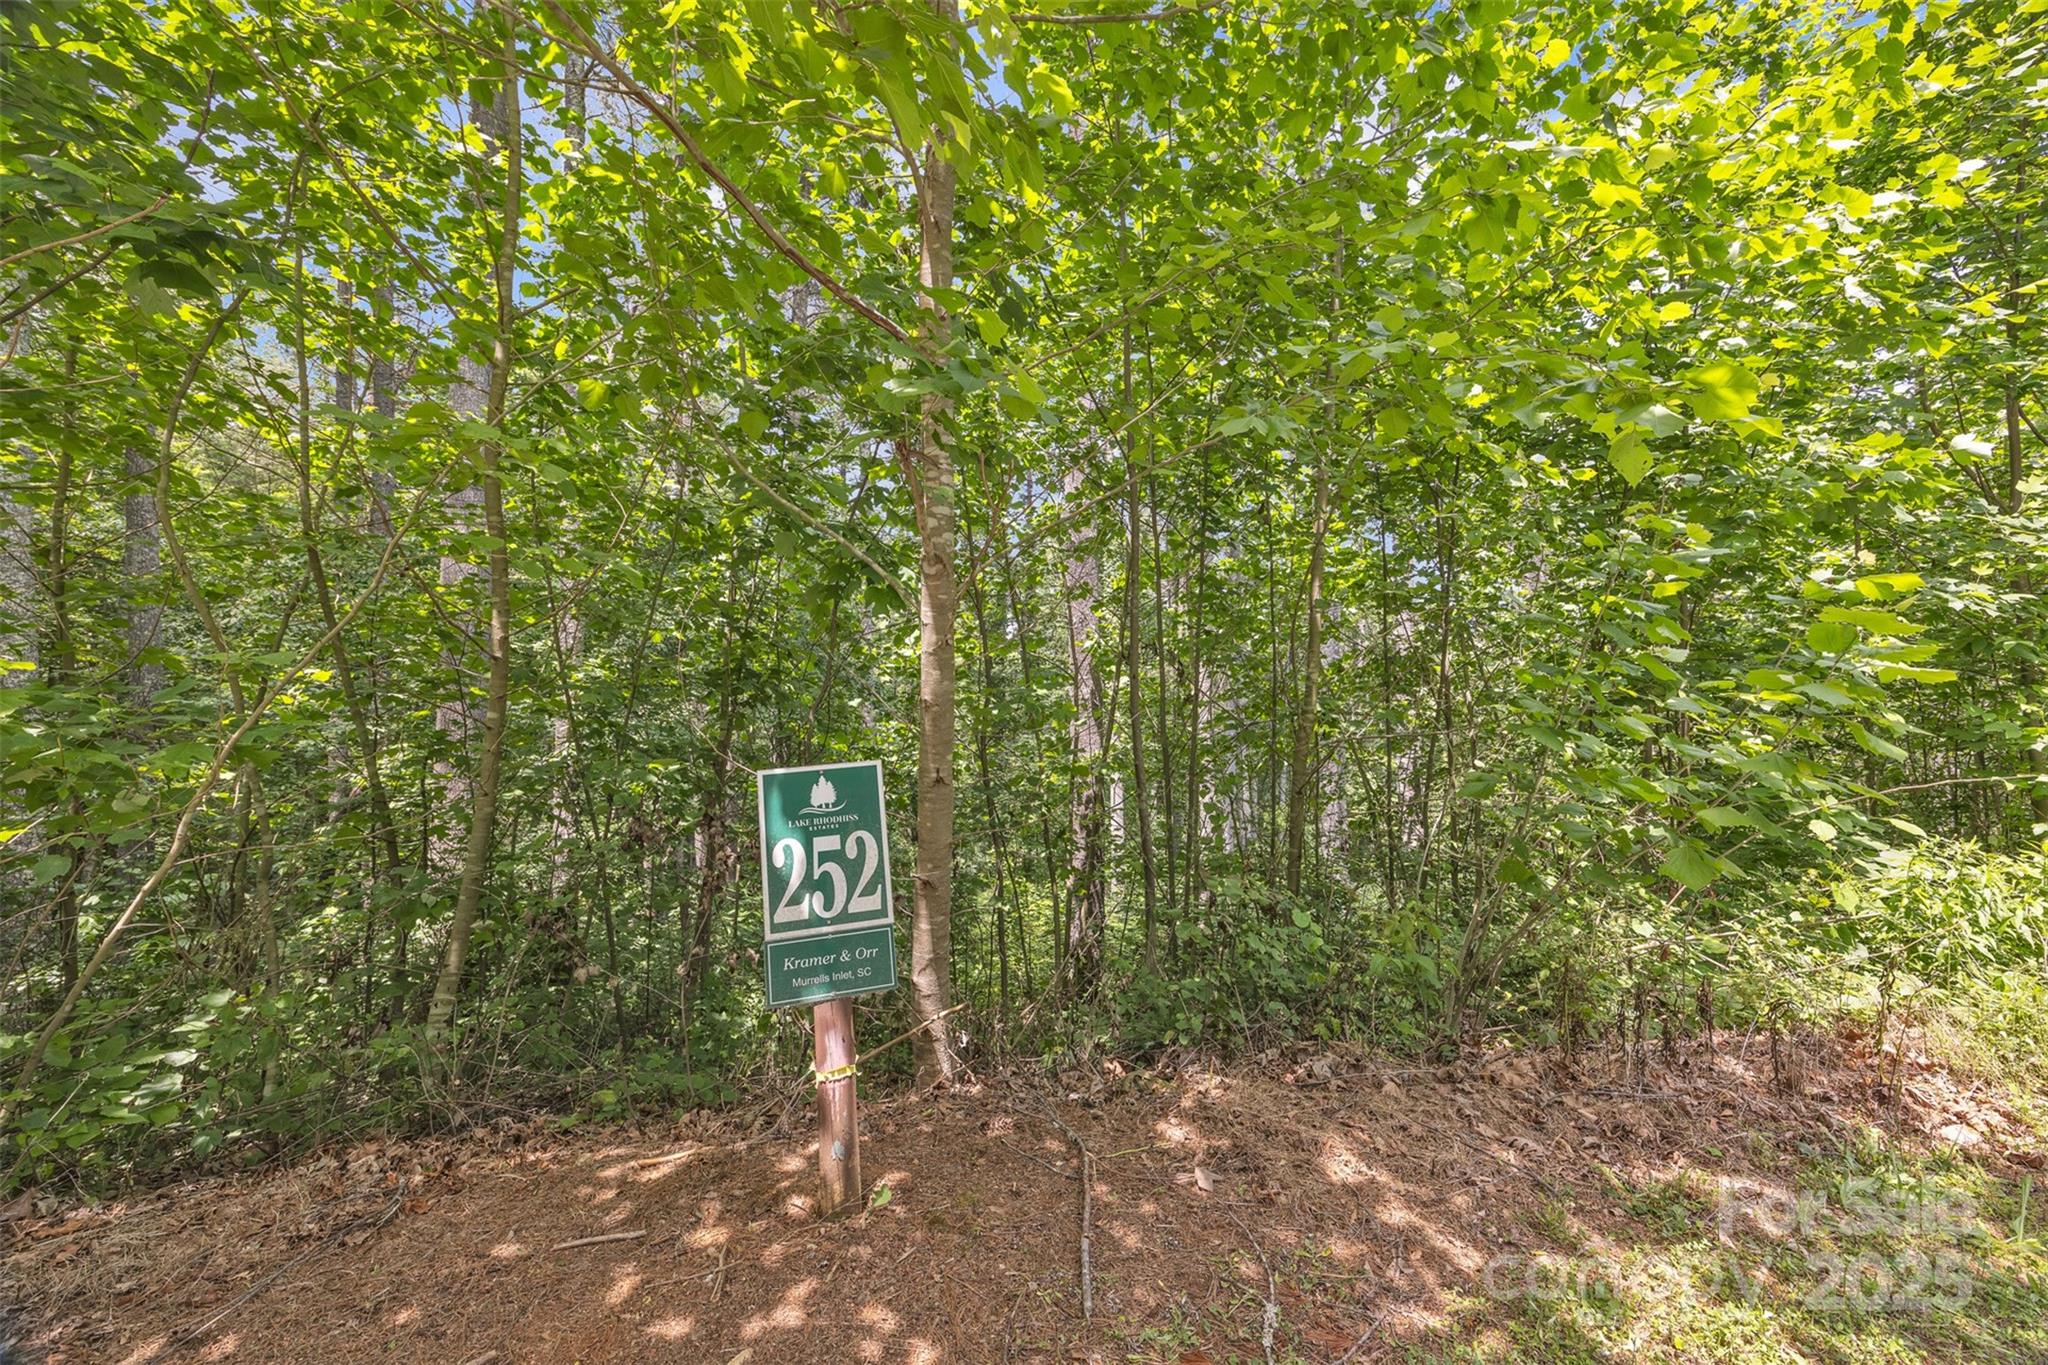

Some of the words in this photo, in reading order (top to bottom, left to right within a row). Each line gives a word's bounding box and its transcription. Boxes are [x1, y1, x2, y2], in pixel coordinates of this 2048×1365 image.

[788, 819, 812, 828] LAKE
[813, 814, 859, 825] RHODHISS
[772, 830, 882, 924] 252
[783, 953, 837, 971] Kramer
[839, 949, 852, 962] &
[855, 947, 879, 960] Orr
[792, 974, 830, 988] Murrells
[832, 970, 855, 981] Inlet,
[857, 967, 872, 978] SC
